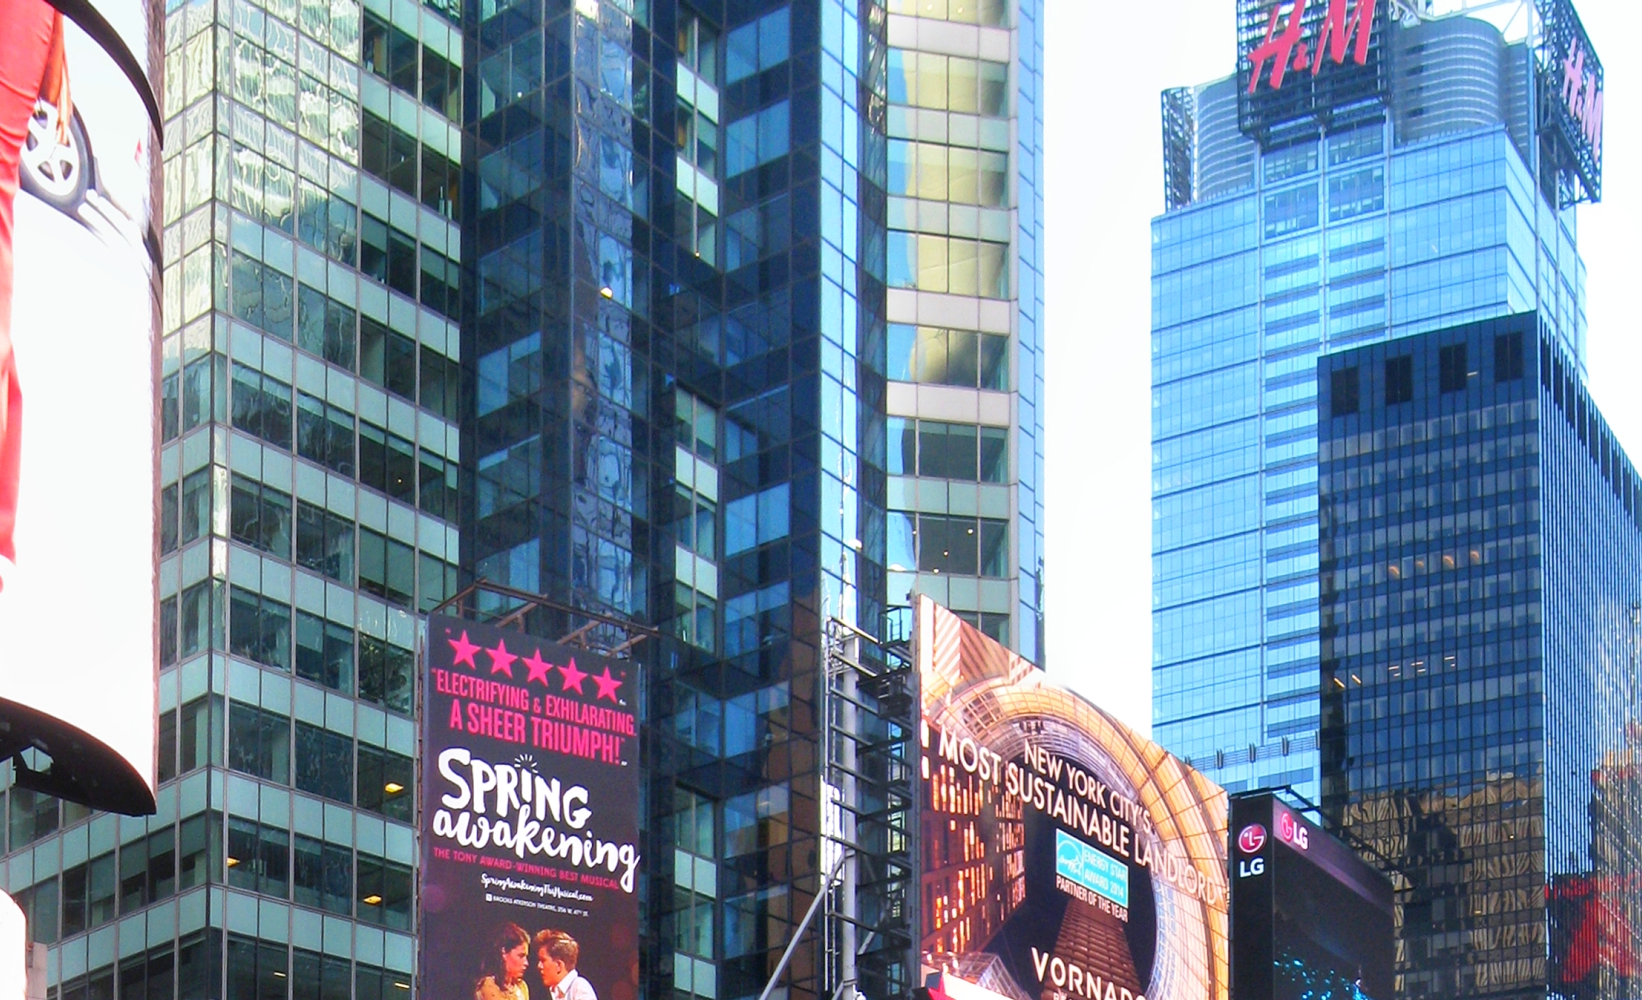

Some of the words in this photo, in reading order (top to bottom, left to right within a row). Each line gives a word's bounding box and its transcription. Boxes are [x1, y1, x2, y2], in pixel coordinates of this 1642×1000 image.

[1248, 0, 1375, 93] H&M
[450, 699, 463, 730] A
[467, 702, 525, 744] SHEER
[533, 698, 541, 713] &
[546, 694, 637, 736] EXHILARATING.
[438, 748, 592, 829] SPRING
[939, 725, 1001, 785] MOST
[1007, 763, 1130, 857] SUSTAINABLE
[1134, 833, 1217, 905] LANDLORD
[1025, 742, 1063, 782] NEW
[1067, 758, 1105, 809] YORK
[1110, 791, 1151, 834] CITY'S
[433, 804, 640, 893] awakening
[1294, 822, 1308, 849] LG
[434, 847, 449, 859] THE
[453, 849, 477, 864] TONY
[479, 855, 556, 878] AWARD-WINNING
[559, 871, 578, 883] BEST
[580, 875, 619, 890] MUSICAL
[1240, 858, 1264, 877] LG
